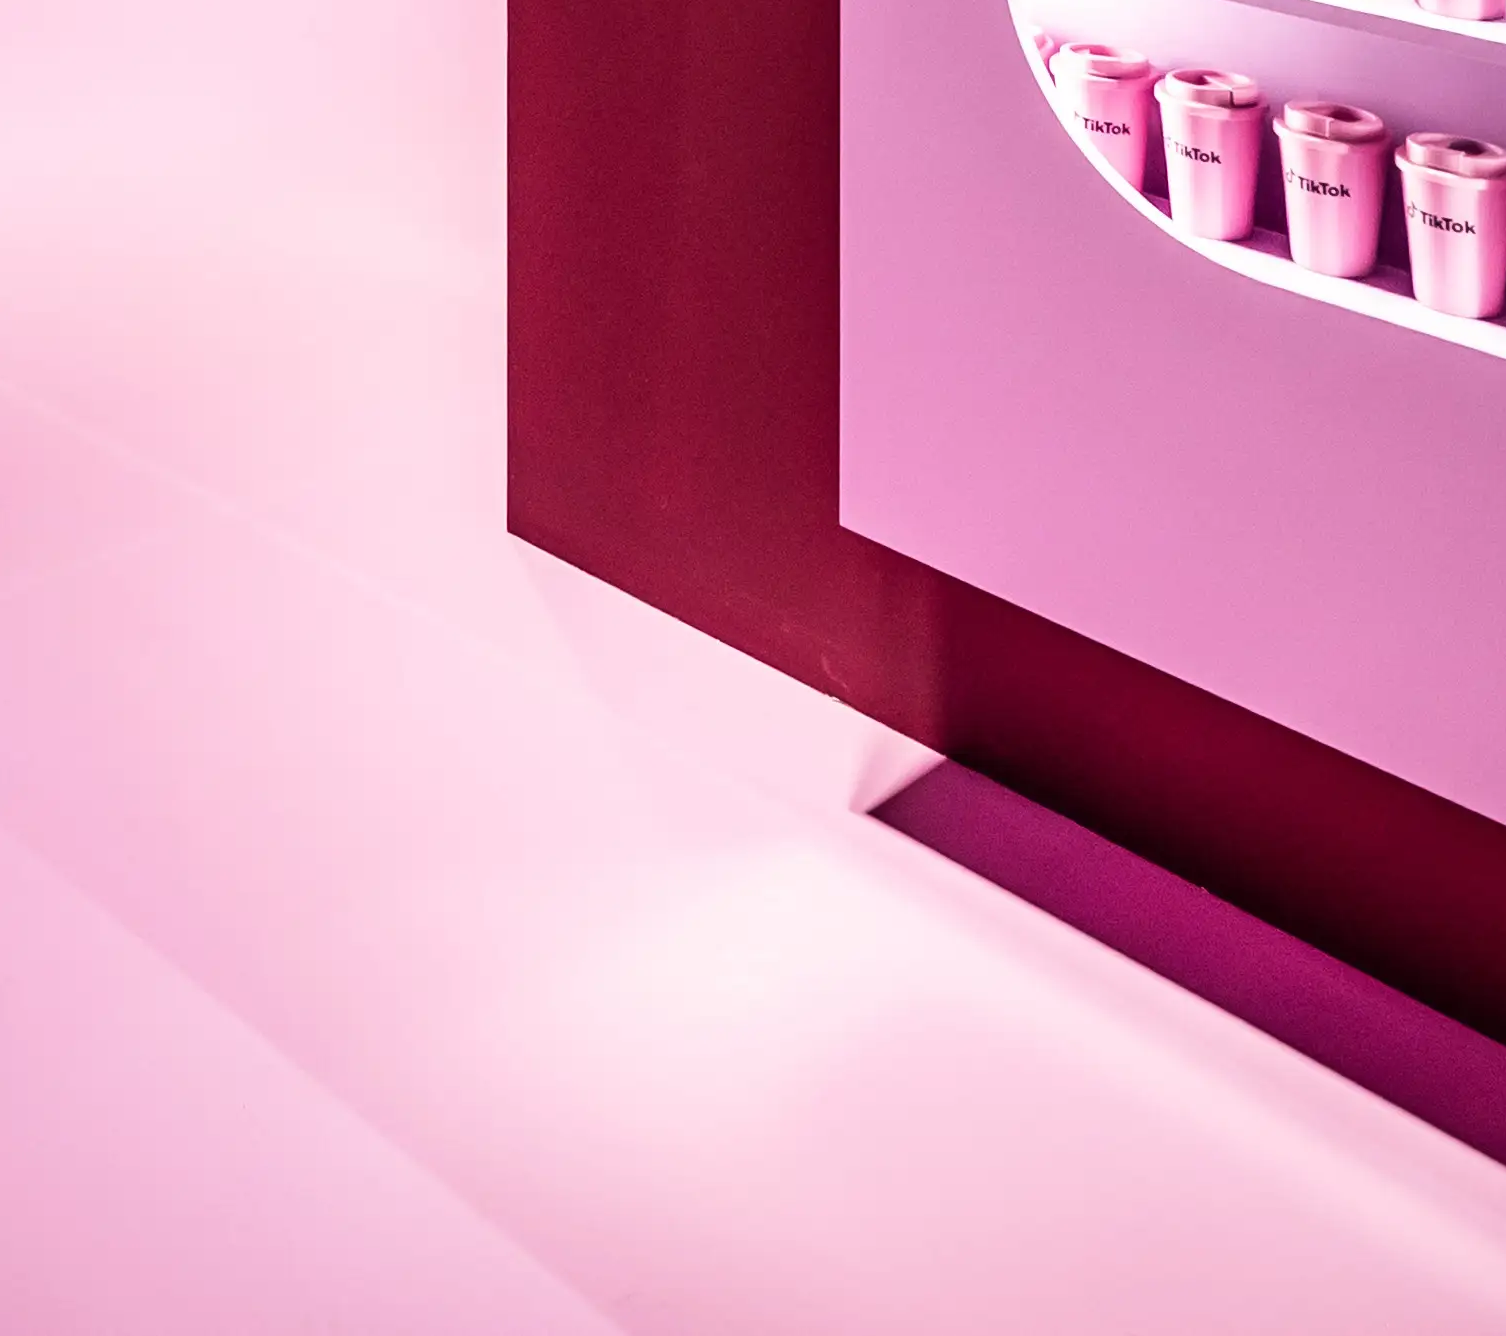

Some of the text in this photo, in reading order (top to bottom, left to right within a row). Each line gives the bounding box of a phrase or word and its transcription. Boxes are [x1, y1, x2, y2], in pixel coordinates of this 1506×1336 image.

[1082, 117, 1132, 136] TikTok
[1298, 176, 1352, 199] TikTok
[1420, 211, 1476, 235] TikTok
